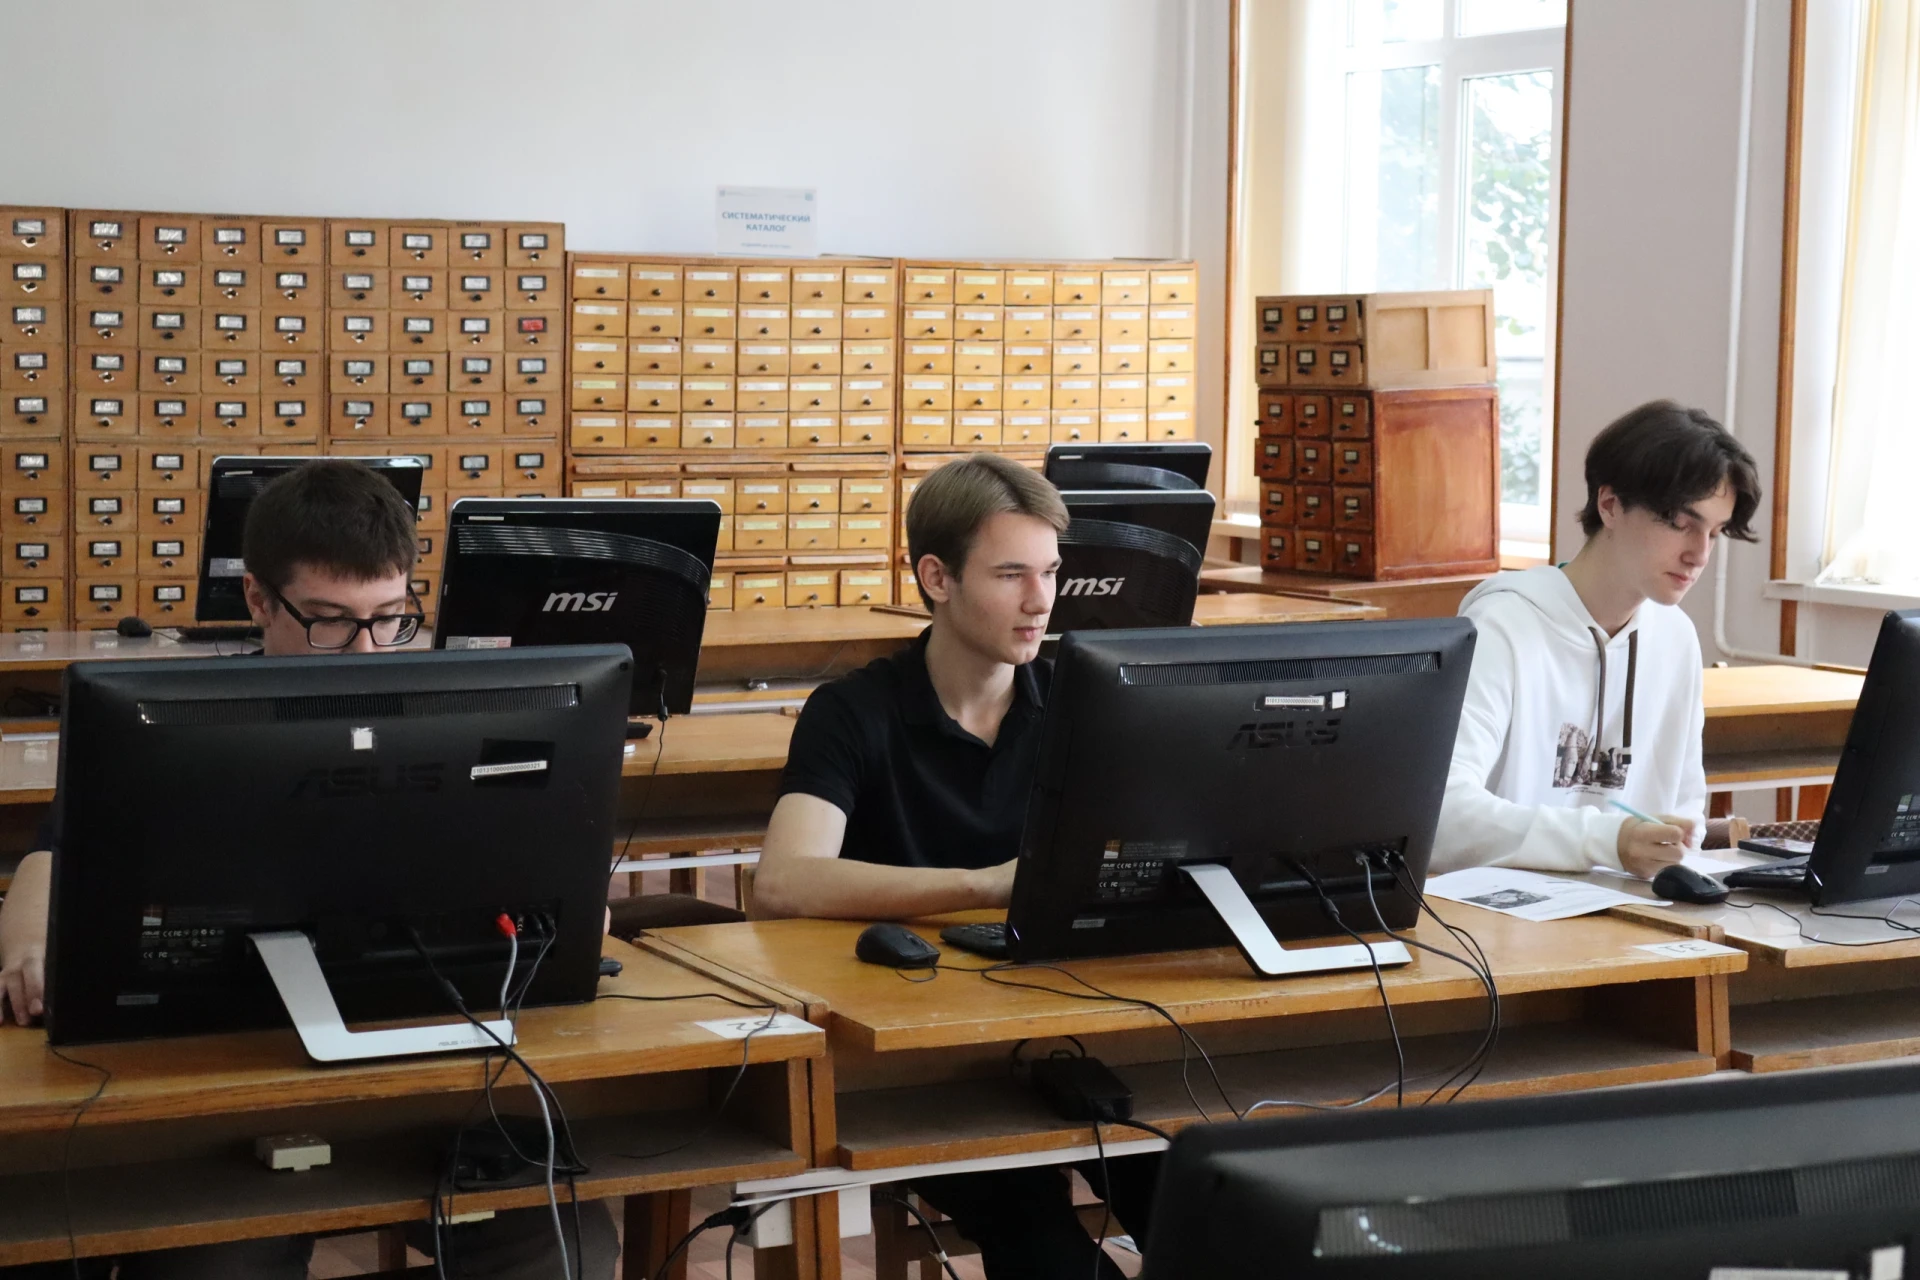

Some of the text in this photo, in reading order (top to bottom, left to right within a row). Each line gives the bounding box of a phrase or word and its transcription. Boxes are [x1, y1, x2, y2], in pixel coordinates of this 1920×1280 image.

[721, 211, 811, 222] СИСТЕМАТИЧЕСКИЙ
[746, 224, 787, 232] КАТАЛОГ
[1059, 577, 1125, 596] msi
[542, 592, 618, 612] msi
